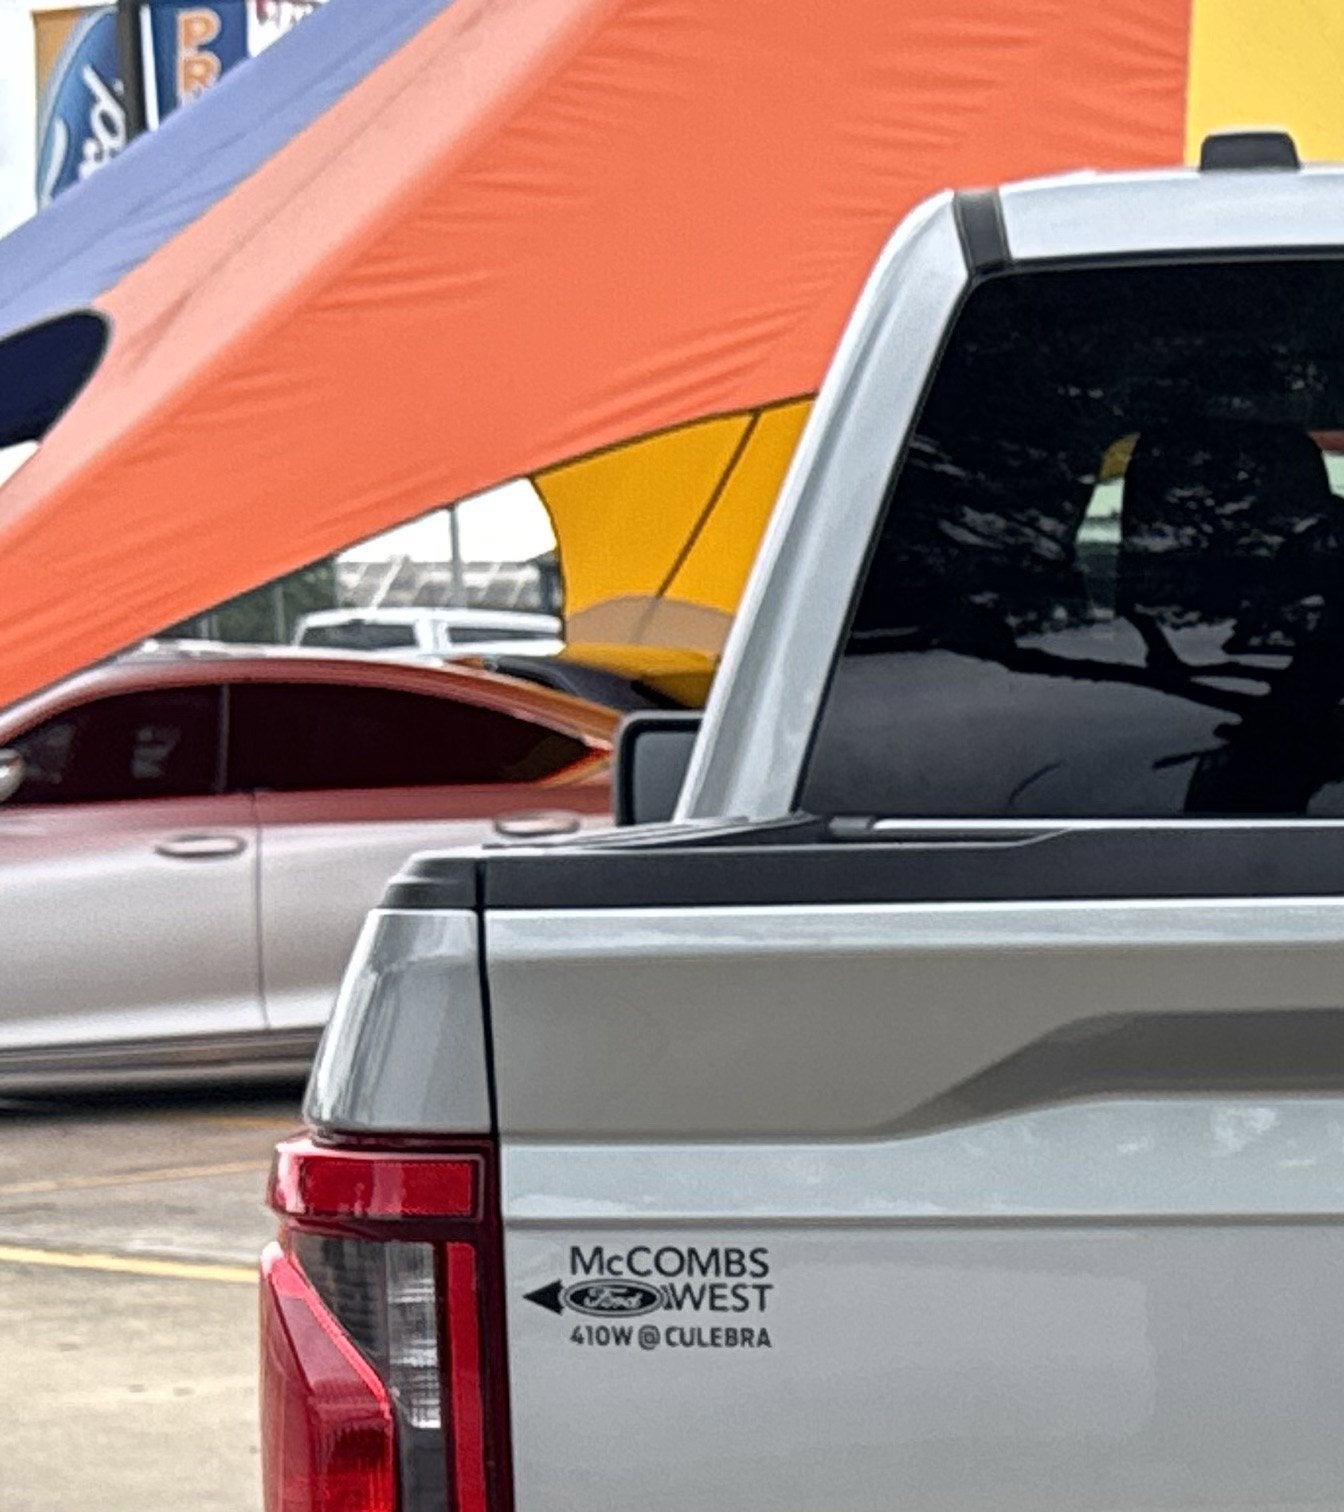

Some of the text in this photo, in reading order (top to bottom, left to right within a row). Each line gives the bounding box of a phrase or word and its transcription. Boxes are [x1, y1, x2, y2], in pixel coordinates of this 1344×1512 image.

[569, 1245, 770, 1279] McCOMBS
[668, 1282, 773, 1313] WEST
[664, 1326, 773, 1348] CULEBRA
